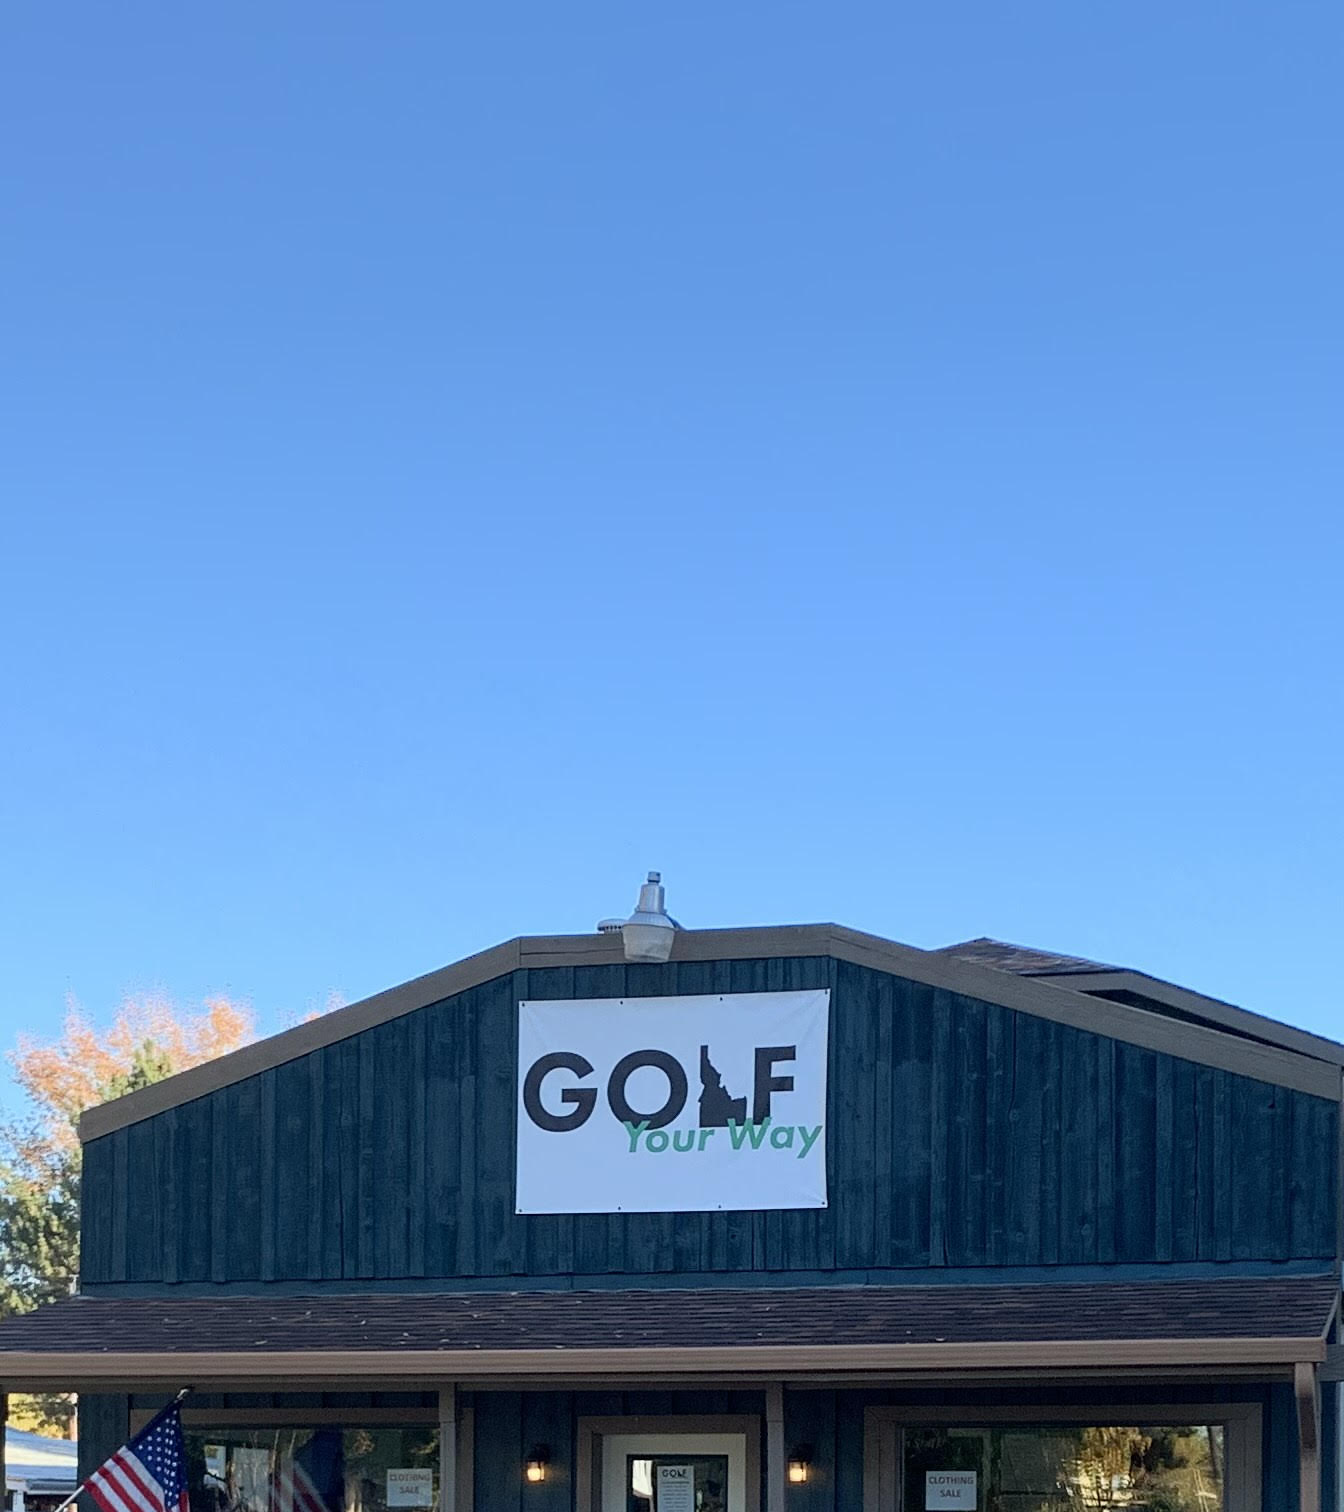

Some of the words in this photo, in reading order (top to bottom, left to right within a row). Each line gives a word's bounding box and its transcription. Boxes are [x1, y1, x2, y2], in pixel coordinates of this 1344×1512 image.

[523, 1045, 796, 1132] GOLF
[623, 1120, 715, 1153] Your
[727, 1117, 823, 1159] Way
[928, 1476, 975, 1485] CLOTHING
[940, 1489, 961, 1498] SALE
